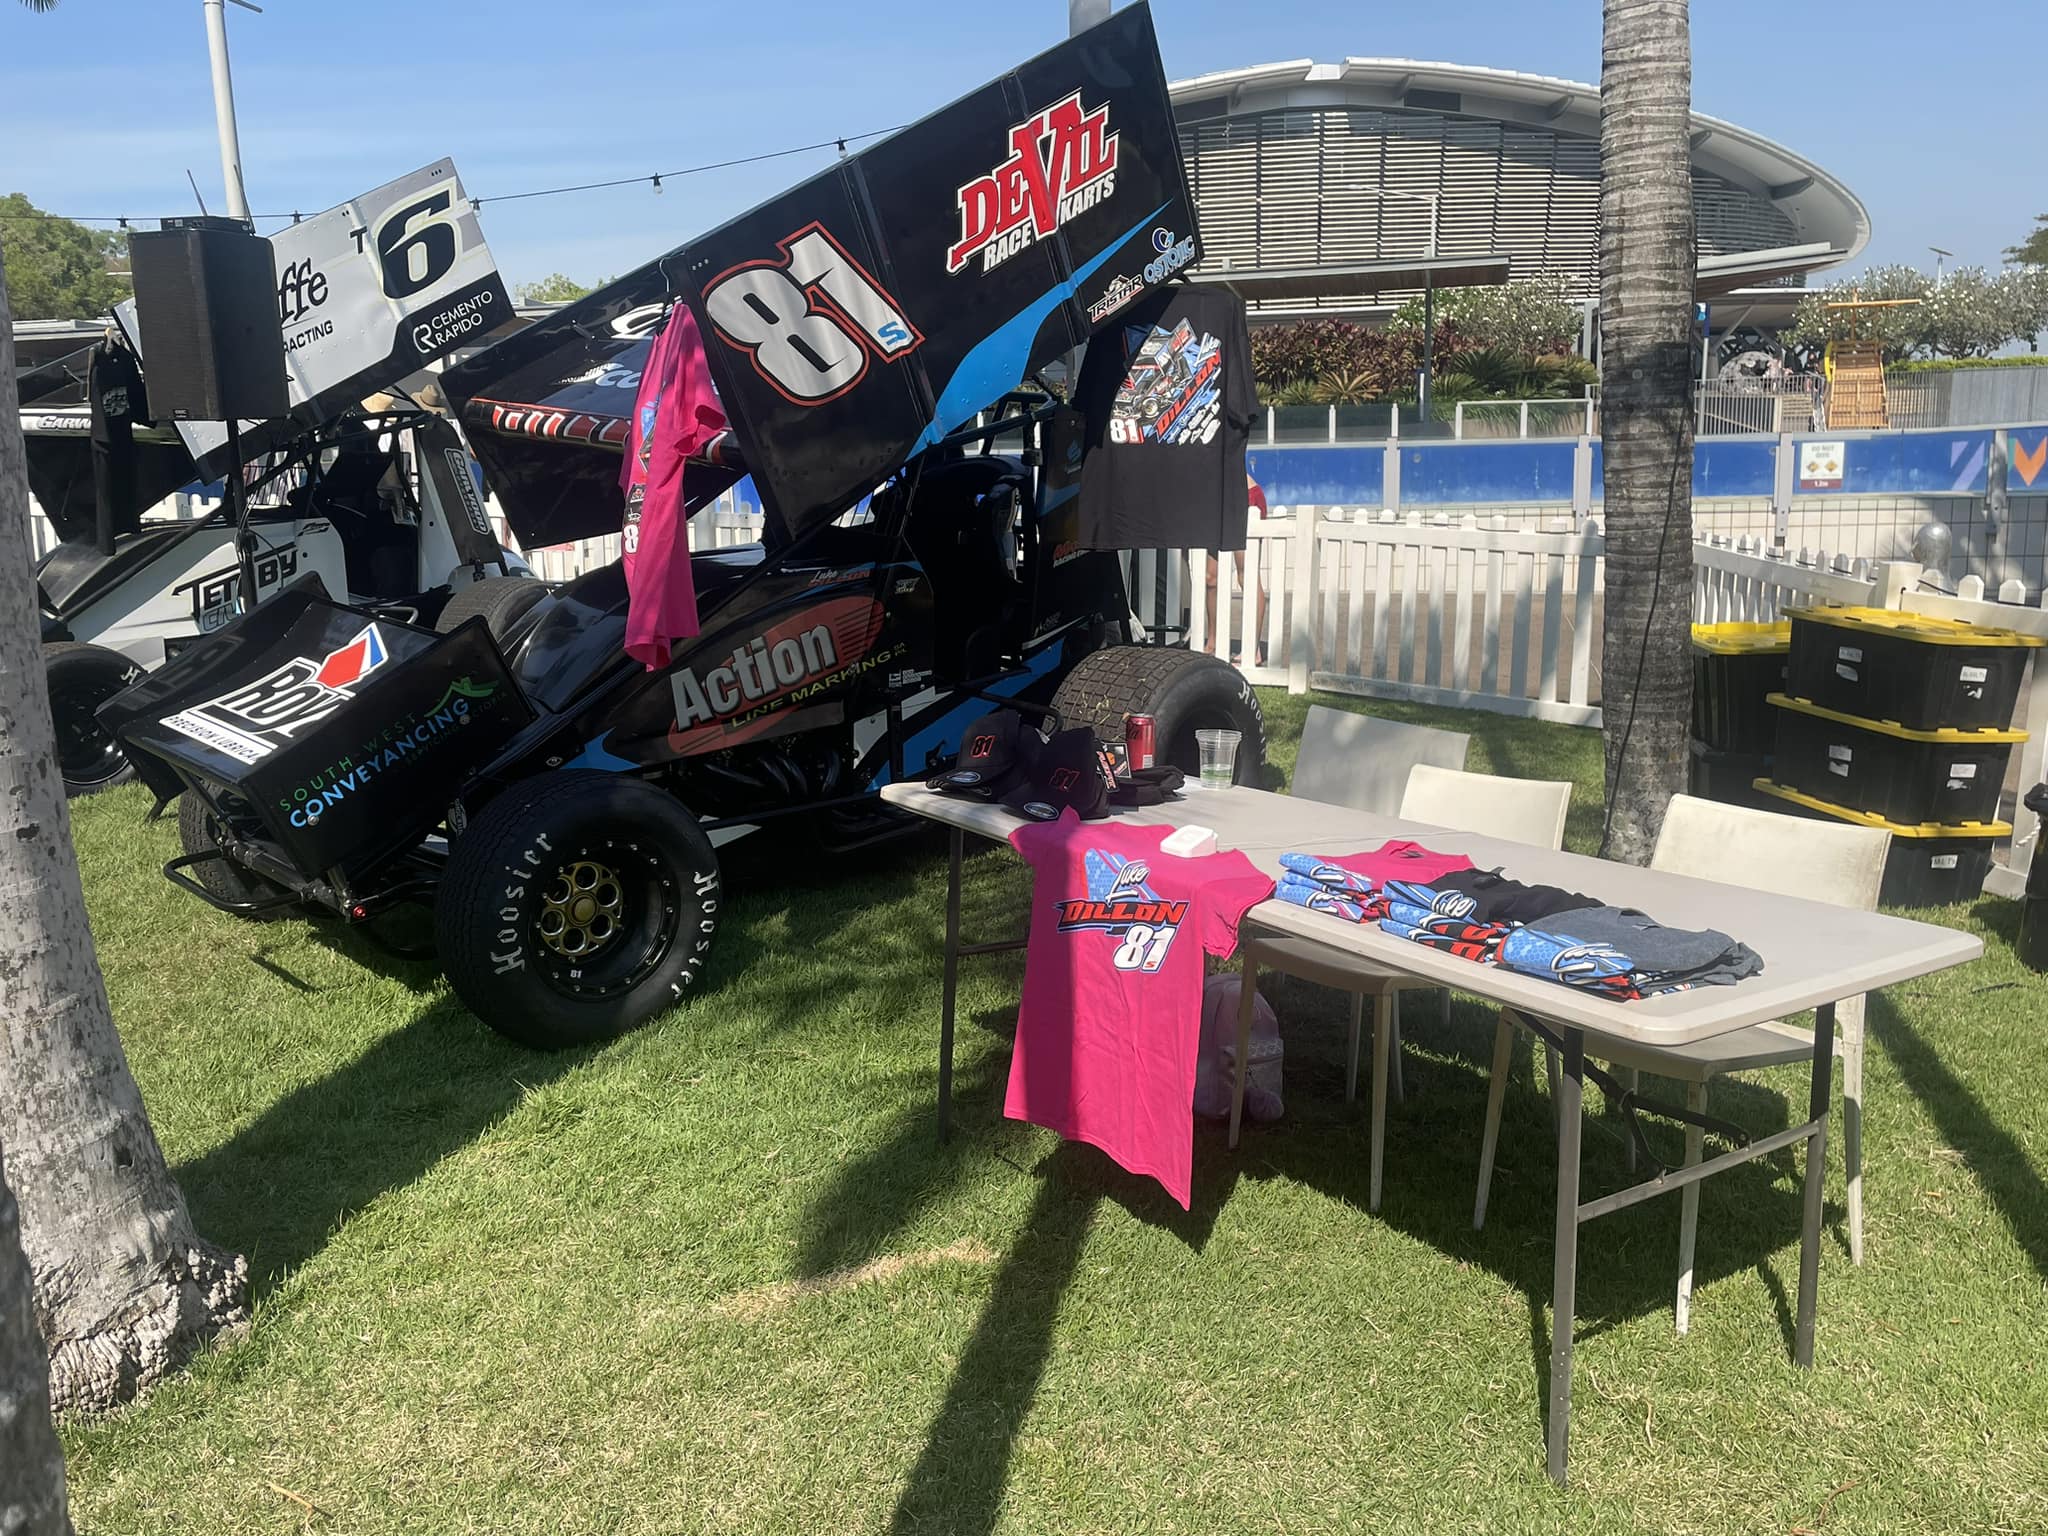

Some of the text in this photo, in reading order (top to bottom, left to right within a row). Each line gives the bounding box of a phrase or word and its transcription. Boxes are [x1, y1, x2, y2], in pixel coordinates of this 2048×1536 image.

[946, 92, 1119, 272] DEVIL
[350, 180, 460, 300] T 6
[983, 173, 1115, 272] RACE KARTS
[431, 290, 493, 330] CEMENTO
[703, 226, 920, 402] 81
[1087, 274, 1144, 319] TRISTAR
[435, 313, 483, 350] RAPIDO
[1110, 418, 1145, 444] 81
[811, 569, 838, 583] Luke
[670, 624, 837, 731] Action
[792, 655, 890, 702] MARKING
[279, 711, 416, 811] SOUTH WEST
[289, 698, 469, 828] CONVEYANCING
[970, 735, 997, 758] 81
[489, 832, 552, 975] Hoosier
[1105, 859, 1149, 903] Luke
[1062, 901, 1186, 922] DILLON
[1112, 923, 1175, 973] 81
